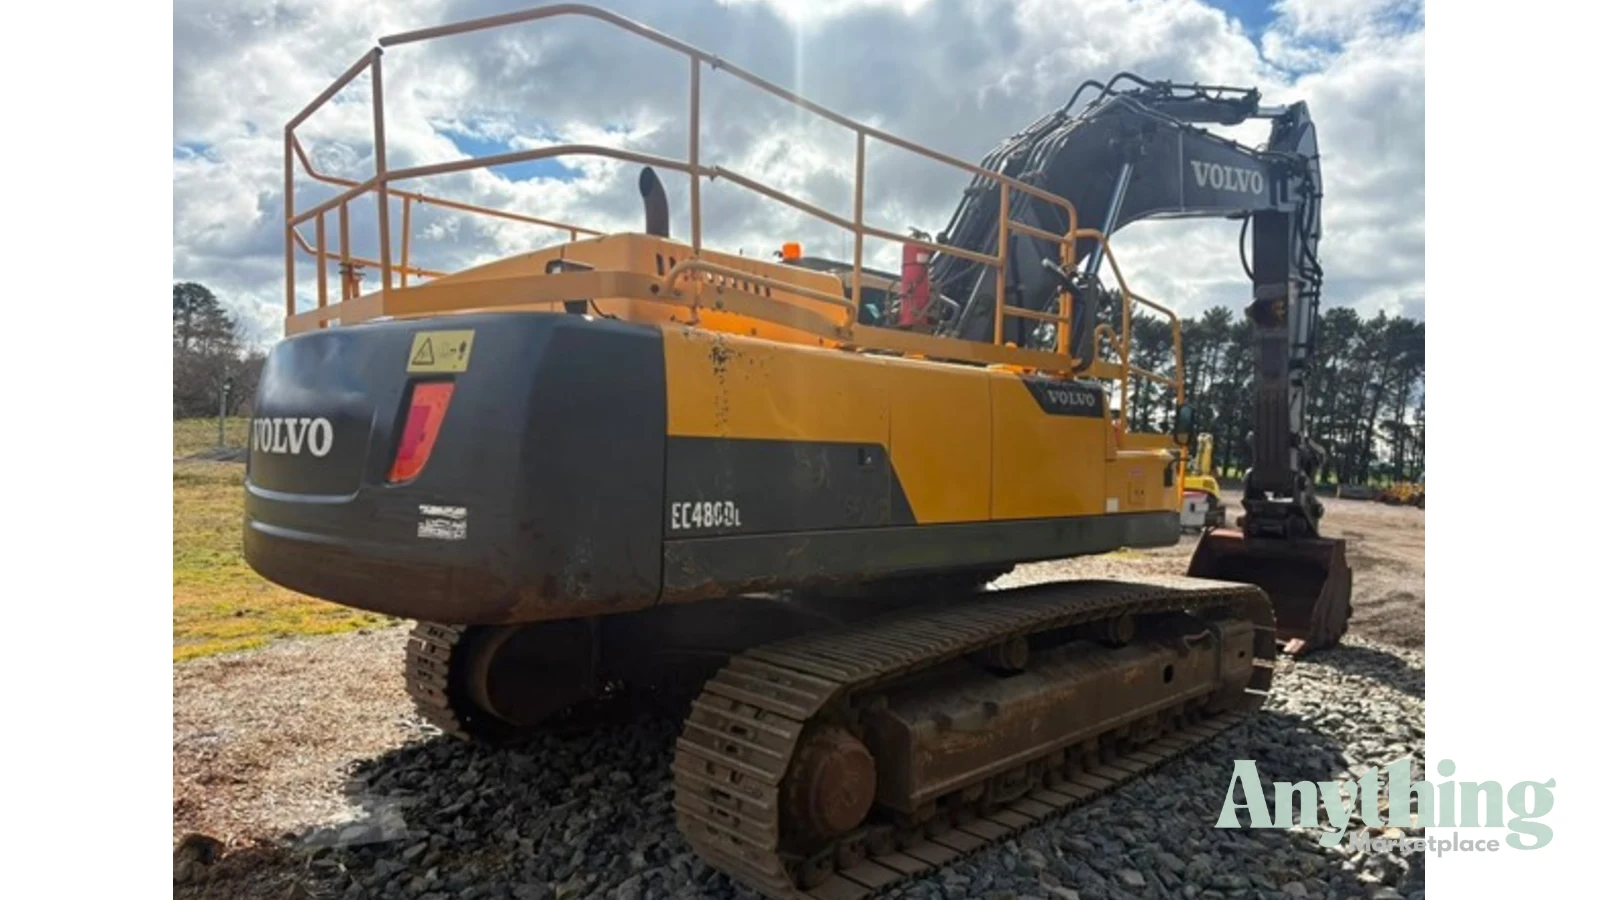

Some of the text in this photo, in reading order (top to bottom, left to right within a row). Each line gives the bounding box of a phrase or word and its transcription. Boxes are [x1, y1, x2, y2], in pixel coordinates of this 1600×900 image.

[1190, 160, 1264, 195] VOLVO
[1047, 389, 1096, 407] VOLVO
[253, 417, 334, 457] VOLVO
